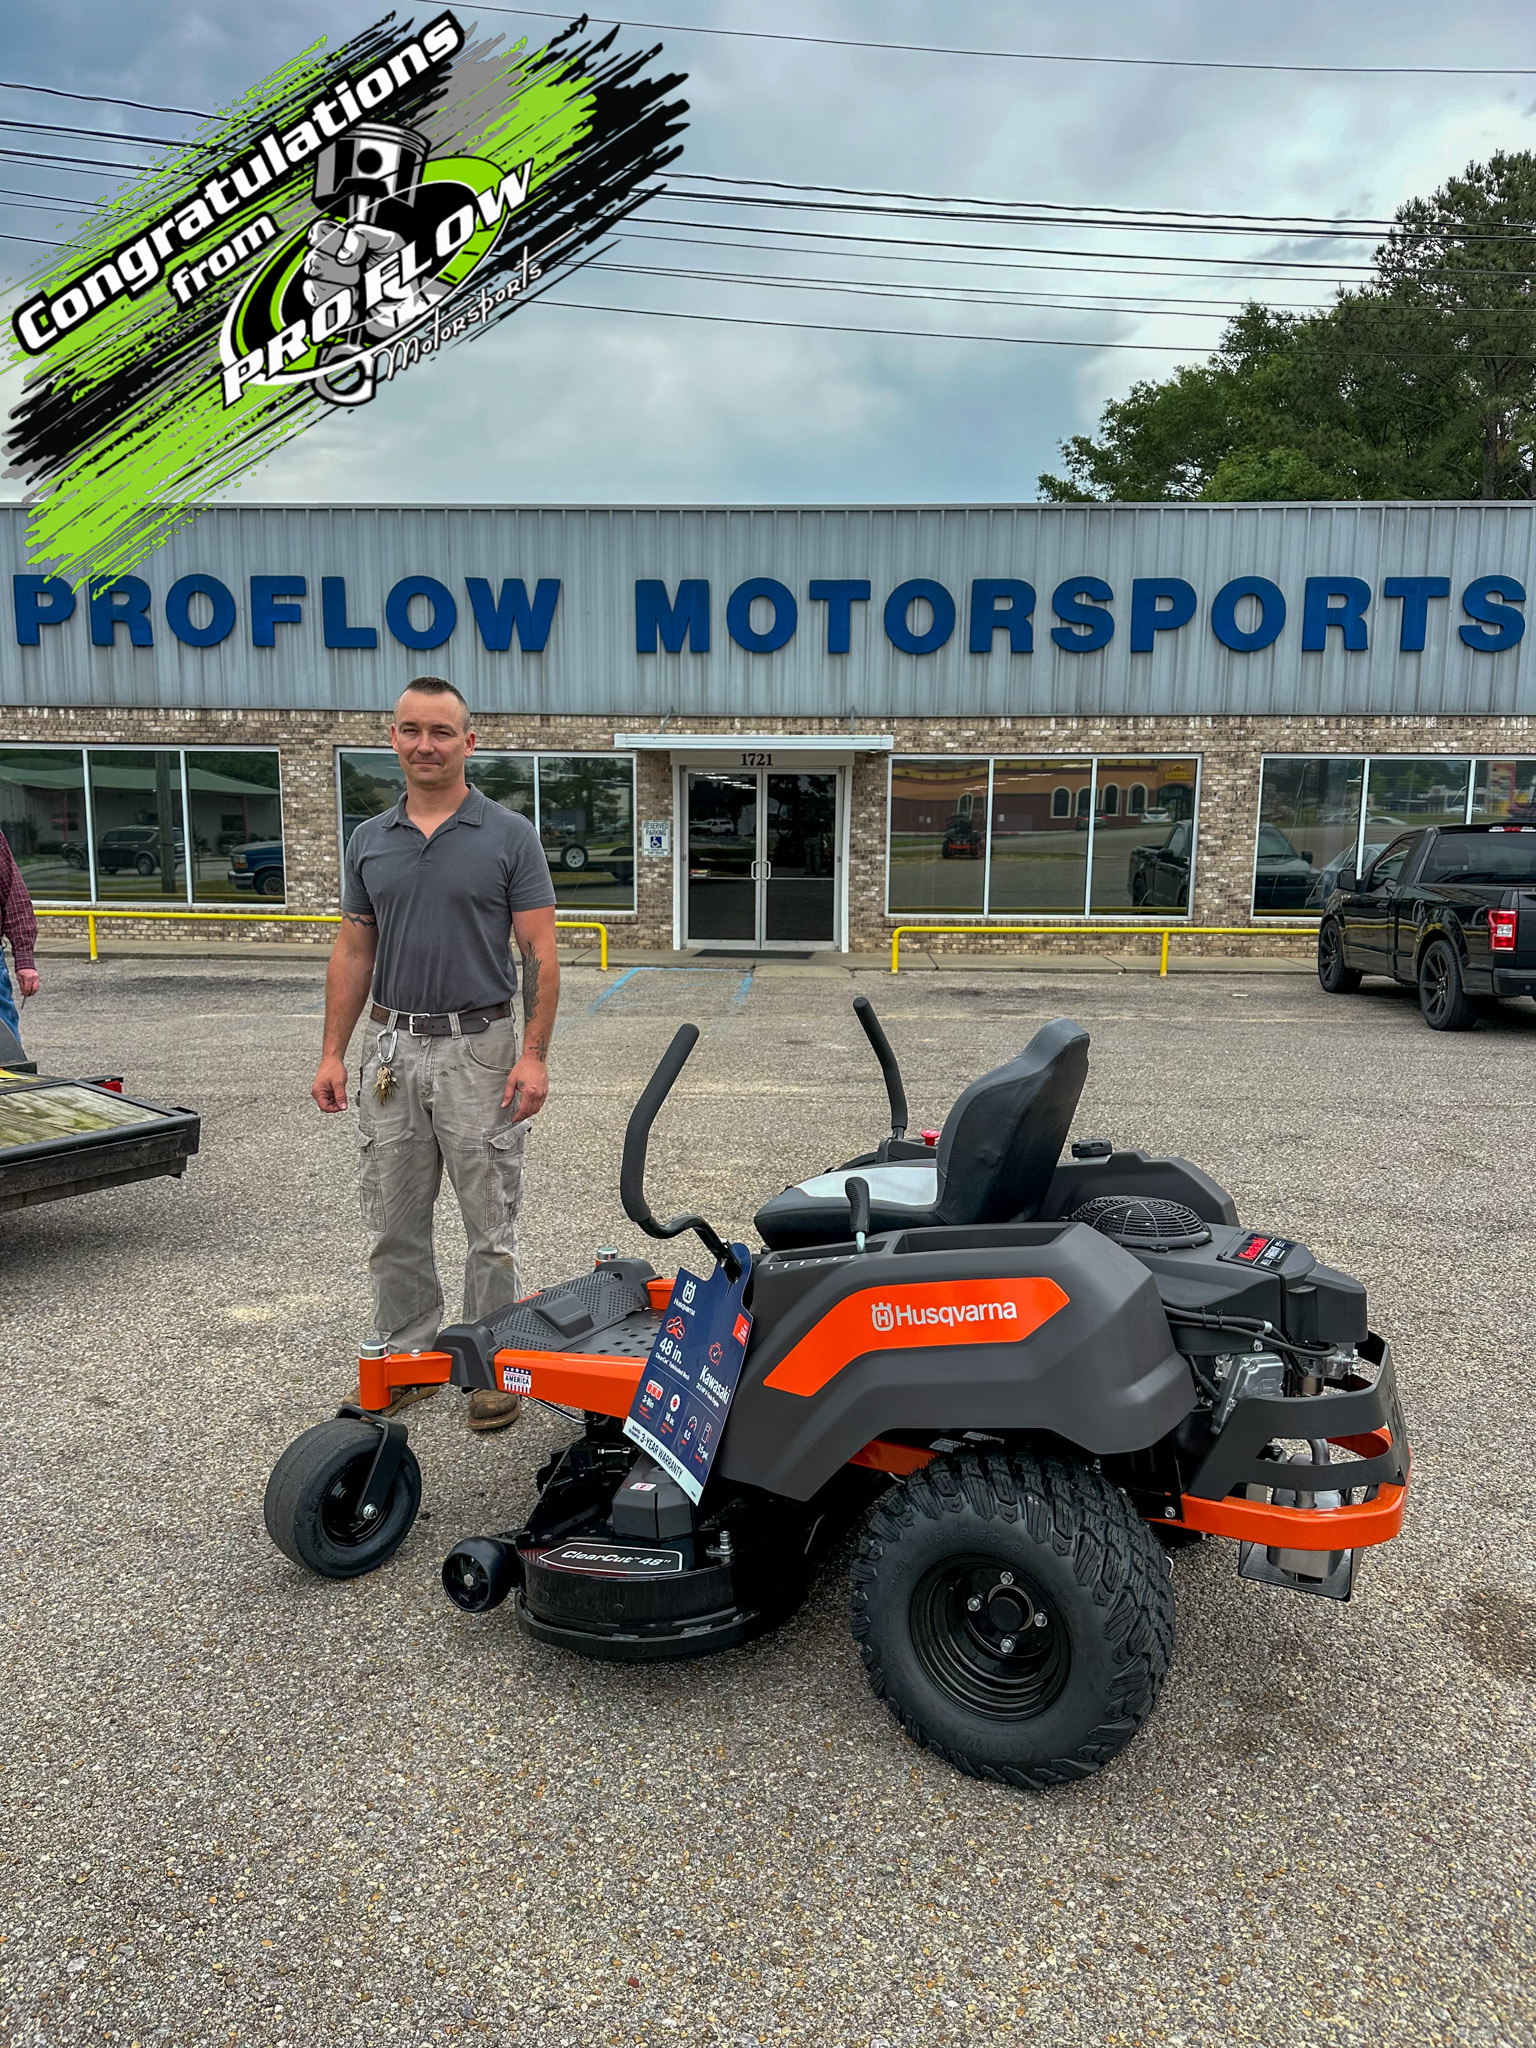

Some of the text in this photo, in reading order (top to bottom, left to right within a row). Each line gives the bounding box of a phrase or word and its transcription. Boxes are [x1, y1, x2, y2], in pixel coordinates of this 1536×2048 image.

[13, 573, 1526, 655] PROFLOW MOTORSPORTS
[741, 753, 773, 766] 1721
[643, 822, 669, 830] RESERVED
[673, 1297, 696, 1316] Husqvarna
[896, 1301, 1018, 1327] Husqvarna
[659, 1337, 682, 1364] 48 in.
[505, 1375, 530, 1385] AMERICA
[700, 1365, 731, 1405] Kawasaki
[639, 1433, 661, 1457] 3-YEAR
[657, 1449, 684, 1478] WARRANTY
